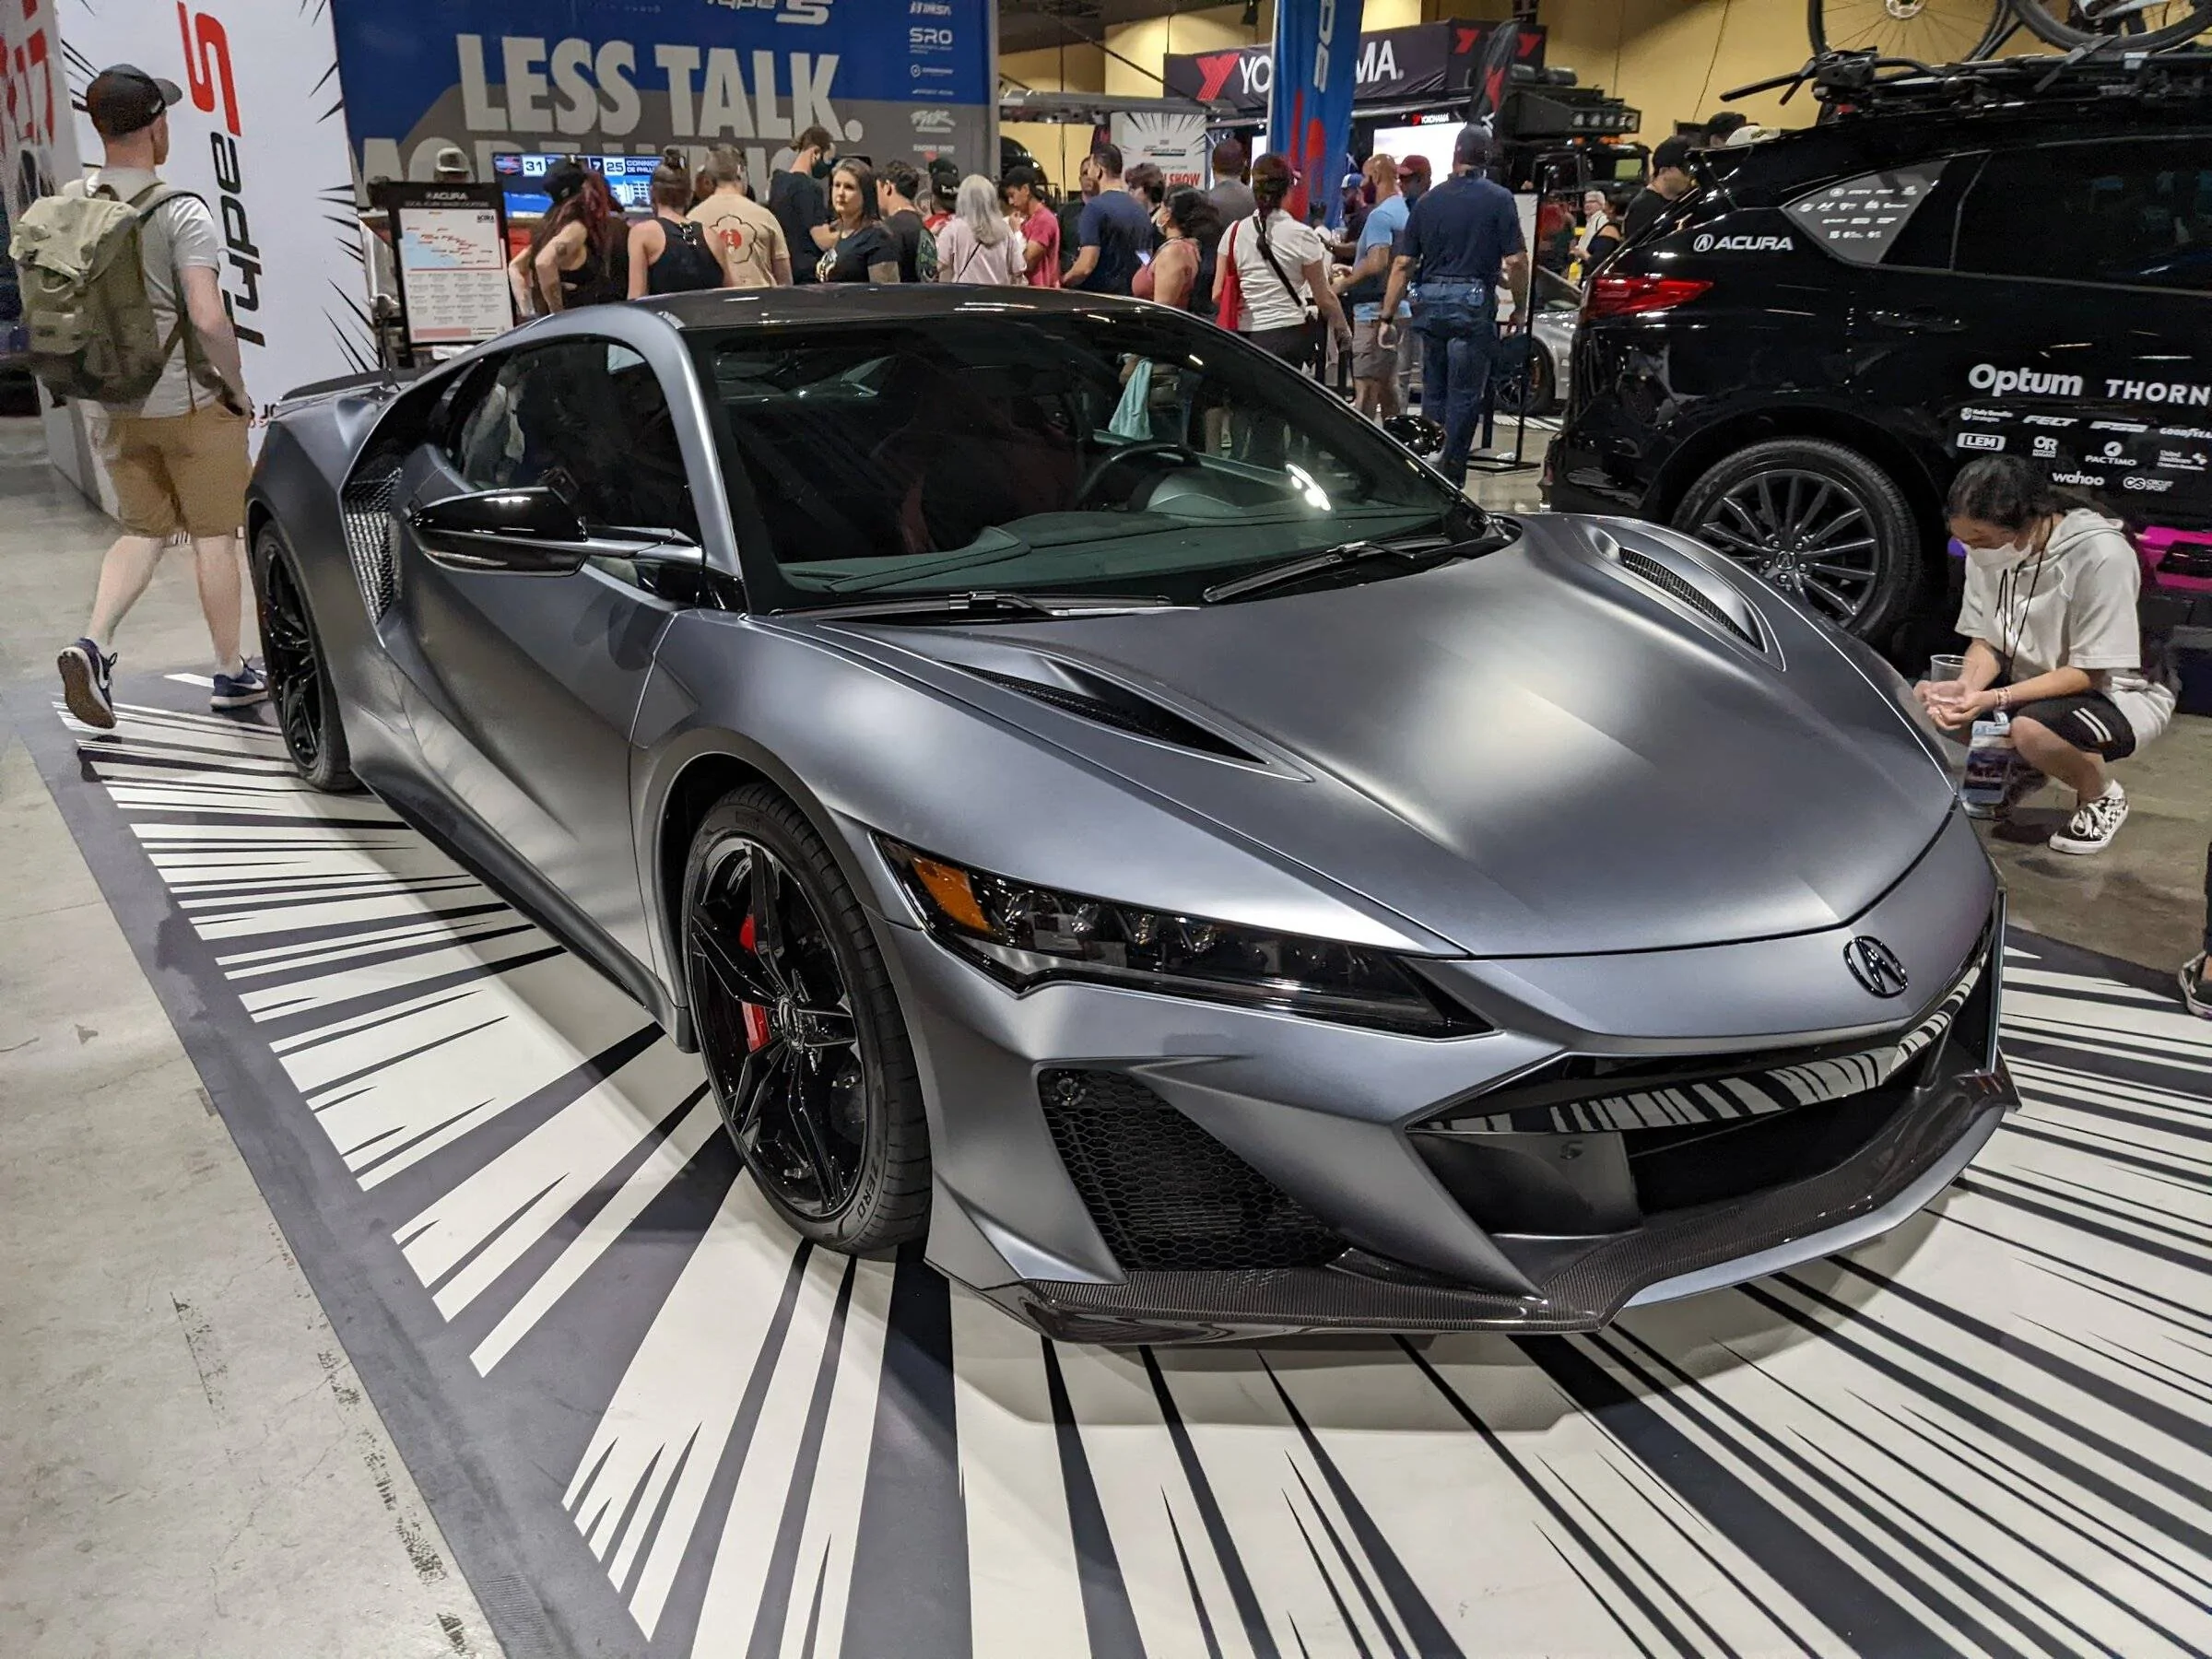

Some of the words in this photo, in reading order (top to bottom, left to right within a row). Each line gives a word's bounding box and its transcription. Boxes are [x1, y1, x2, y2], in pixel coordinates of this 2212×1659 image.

[910, 28, 952, 44] SRO
[177, 1, 241, 136] S
[1239, 40, 1398, 94] YOMA
[456, 33, 641, 135] LESS
[654, 44, 864, 143] TALK.
[525, 160, 543, 172] 31
[606, 162, 625, 173] 25
[1169, 172, 1200, 185] SHOW
[432, 192, 467, 200] ACURA
[1713, 235, 1794, 251] ACURA
[1968, 363, 2084, 397] Optum
[2022, 415, 2079, 426] FELT
[2159, 427, 2212, 439] GOODYEA
[1966, 436, 1996, 447] LEM
[2034, 435, 2059, 451] OR
[2085, 454, 2137, 466] PACTIMO
[2052, 470, 2105, 486] wahoo
